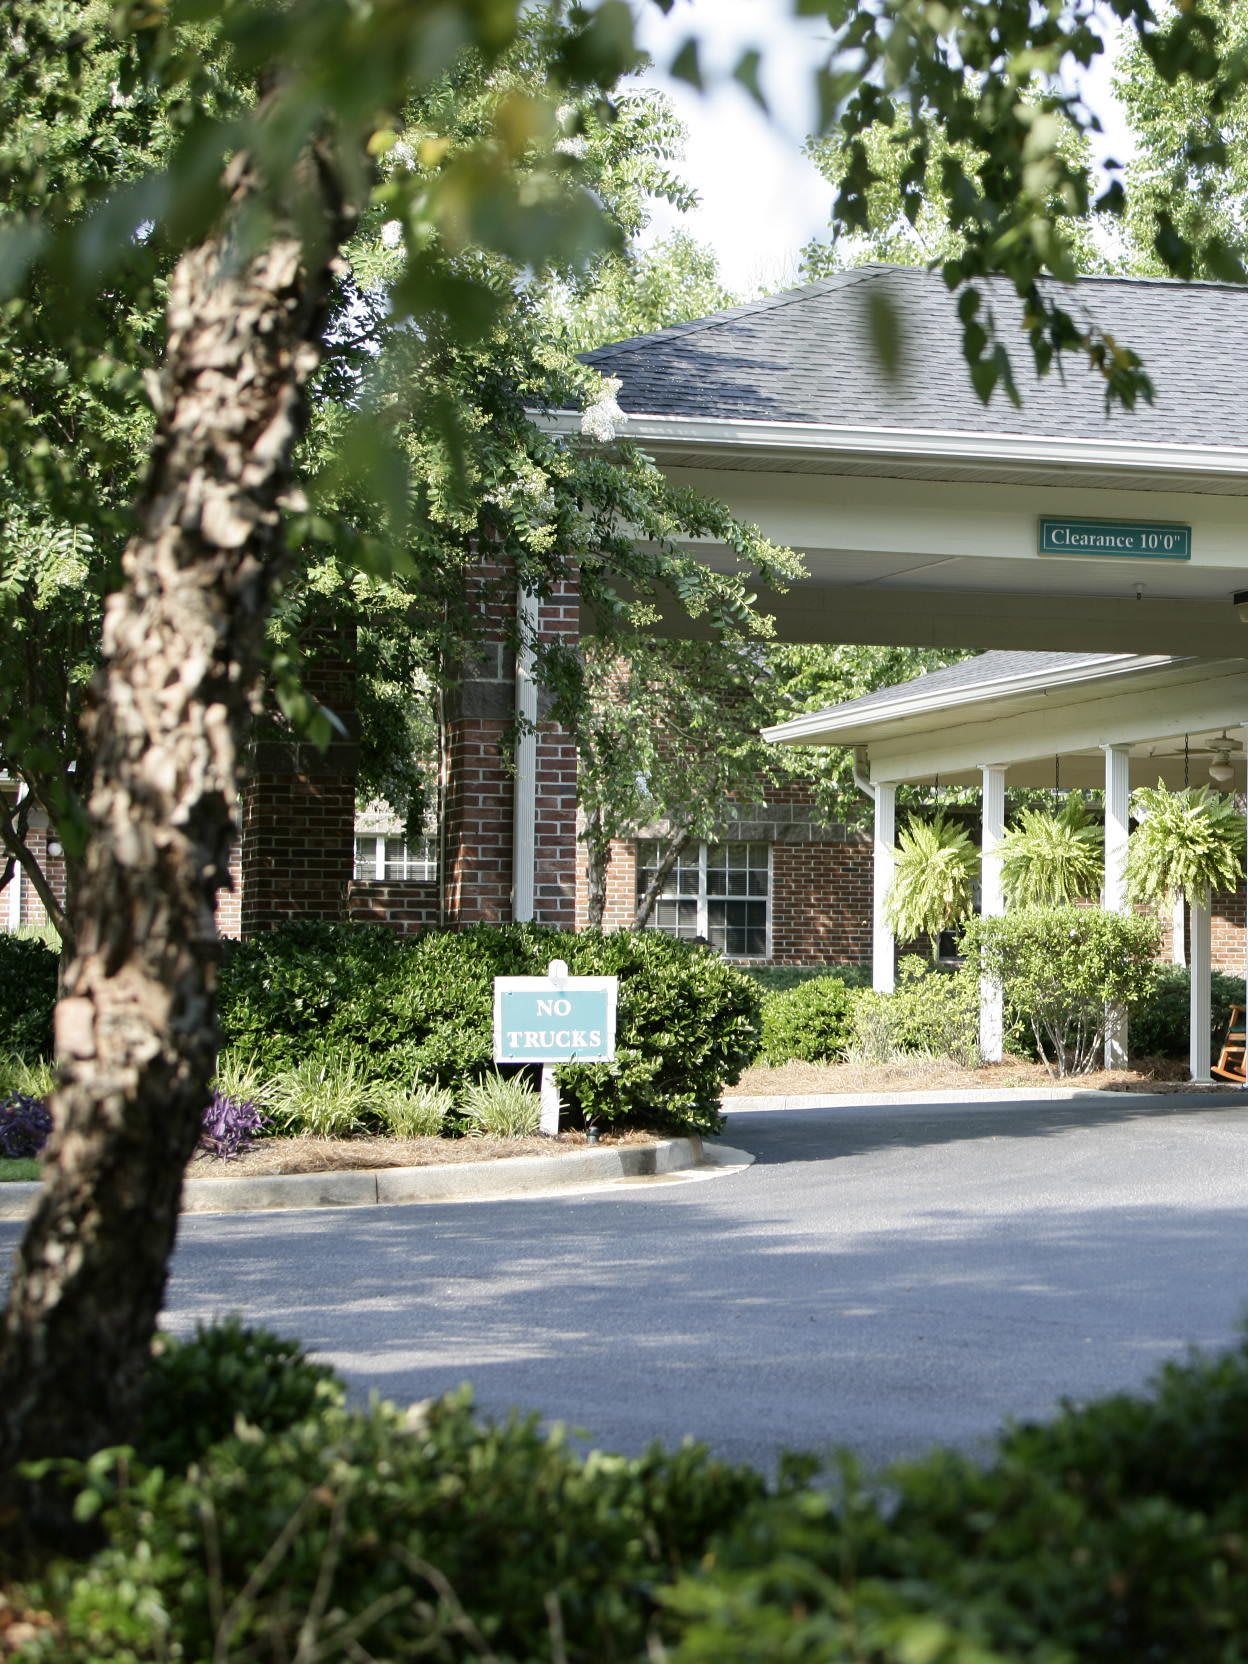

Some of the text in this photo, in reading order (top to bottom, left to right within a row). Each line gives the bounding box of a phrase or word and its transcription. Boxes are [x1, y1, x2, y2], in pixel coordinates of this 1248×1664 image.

[1051, 529, 1181, 550] Clearance 10'0"
[536, 999, 572, 1016] NO
[507, 1030, 601, 1048] TRUCKS
